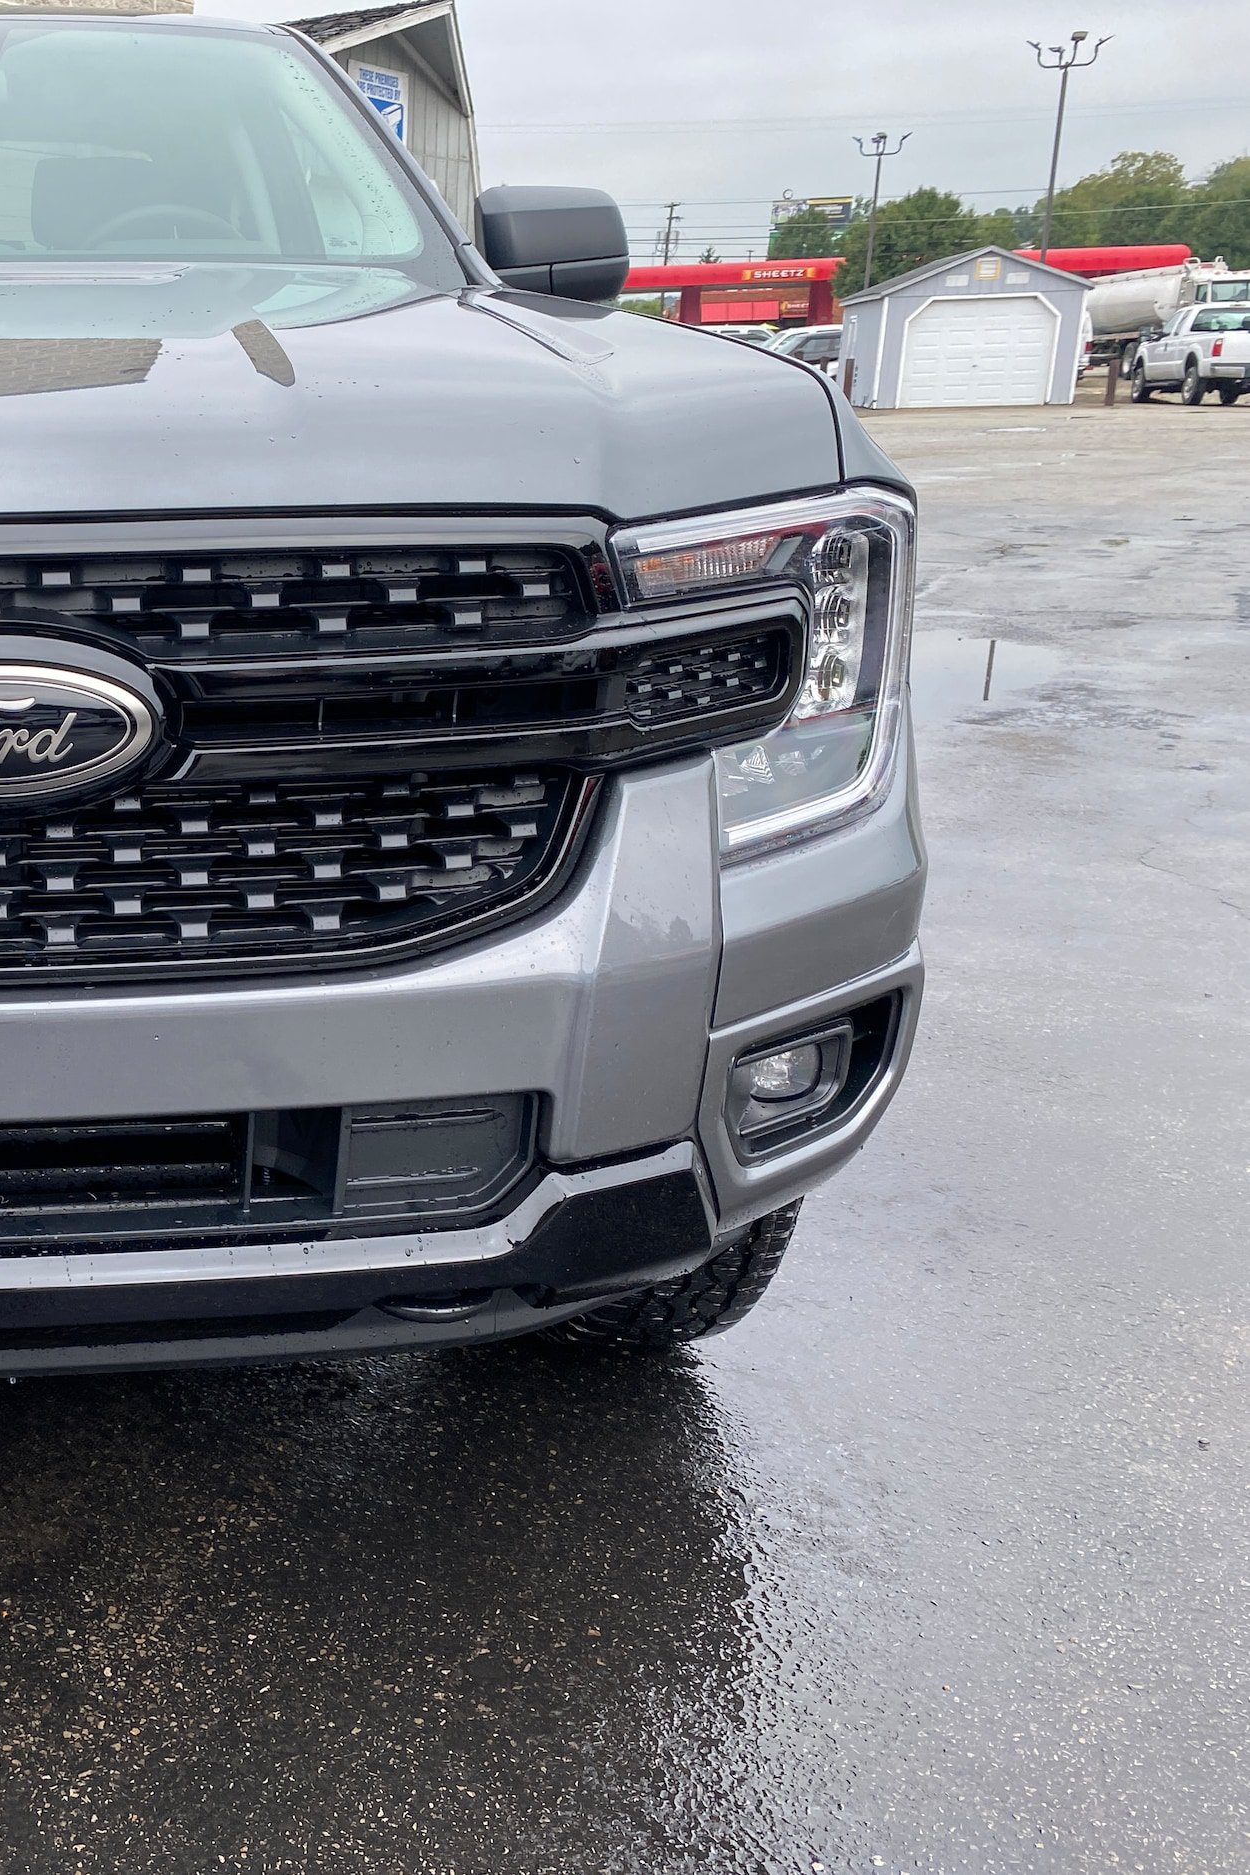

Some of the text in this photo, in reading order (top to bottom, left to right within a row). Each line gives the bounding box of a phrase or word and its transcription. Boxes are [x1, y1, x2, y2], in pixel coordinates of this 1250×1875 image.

[375, 72, 398, 88] PREMISES
[367, 82, 394, 100] PROTECTED
[753, 269, 804, 278] SHEETZ
